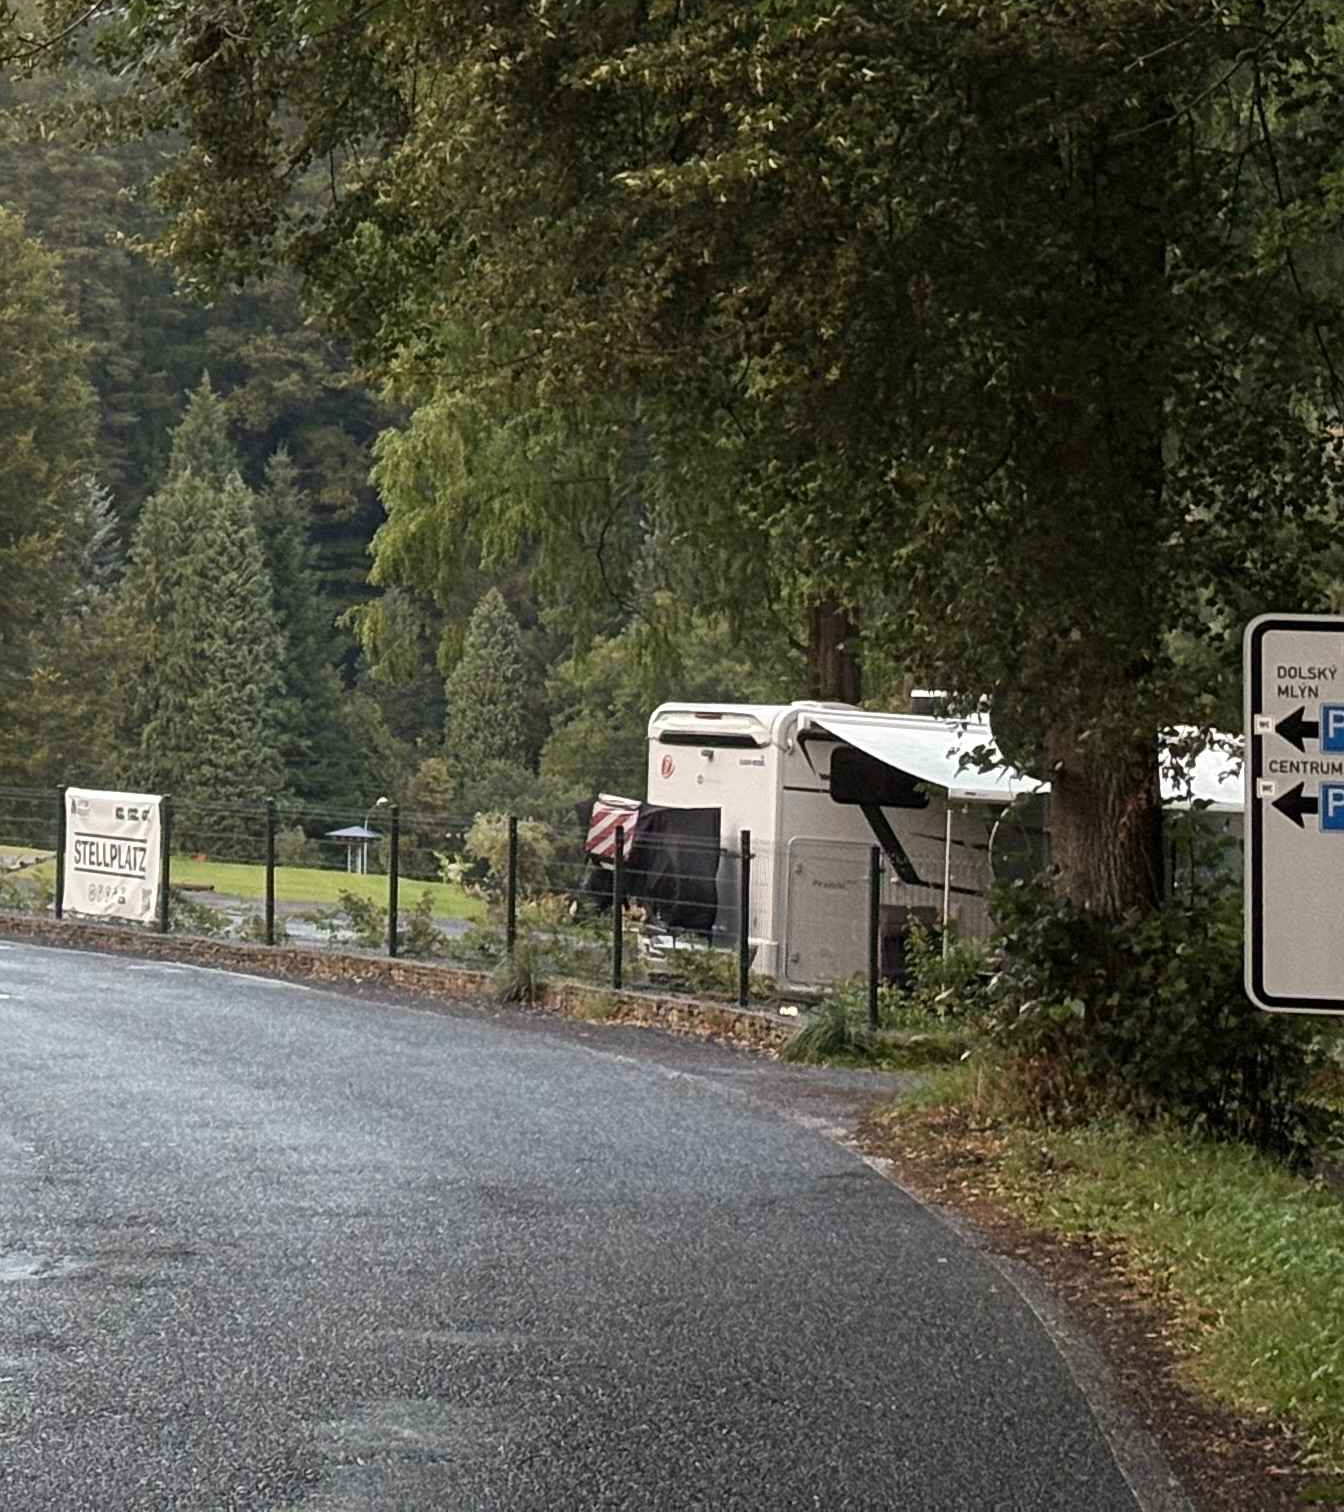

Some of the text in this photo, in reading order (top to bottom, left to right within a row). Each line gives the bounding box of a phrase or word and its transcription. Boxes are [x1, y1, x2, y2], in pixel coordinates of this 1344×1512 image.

[1277, 664, 1337, 681] DOLSKÝ
[1277, 682, 1319, 699] MLÝN
[1269, 760, 1343, 775] CENTRUM
[74, 839, 147, 872] STELLPLATZ
